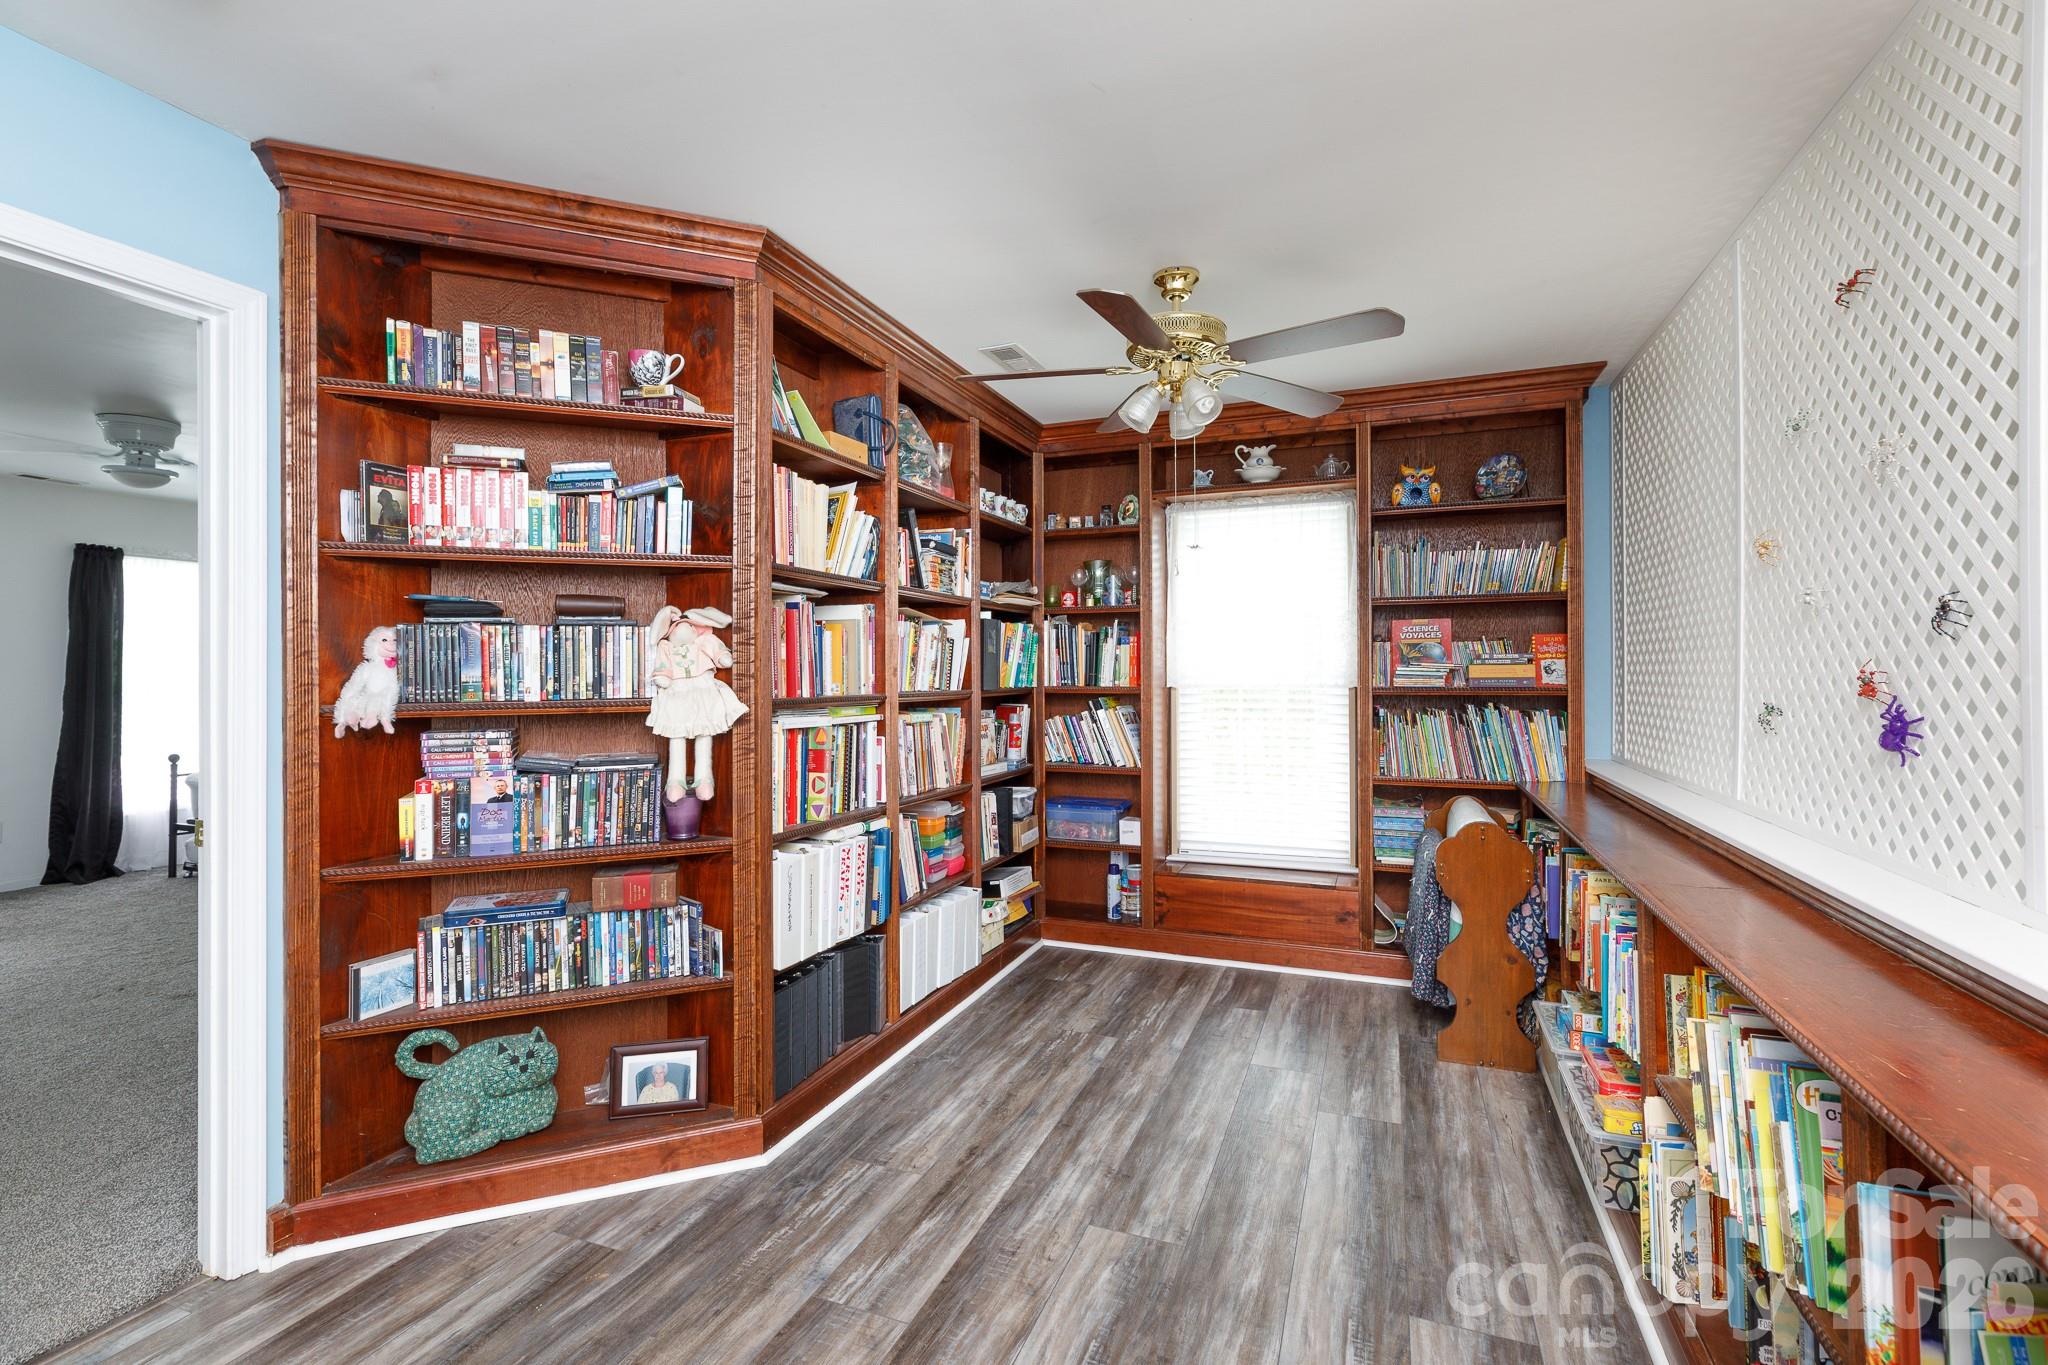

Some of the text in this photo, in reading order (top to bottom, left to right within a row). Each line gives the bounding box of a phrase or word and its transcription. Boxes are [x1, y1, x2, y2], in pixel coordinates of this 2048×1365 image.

[373, 474, 406, 487] EVITA
[411, 471, 420, 505] MONK
[428, 473, 437, 505] MONK
[444, 472, 452, 506] MONK
[474, 475, 482, 506] MONK
[503, 477, 513, 509] MONK
[1400, 631, 1442, 639] VOYAGES
[1402, 625, 1439, 633] SCIENCE
[441, 795, 451, 845] LEFT BEHIND
